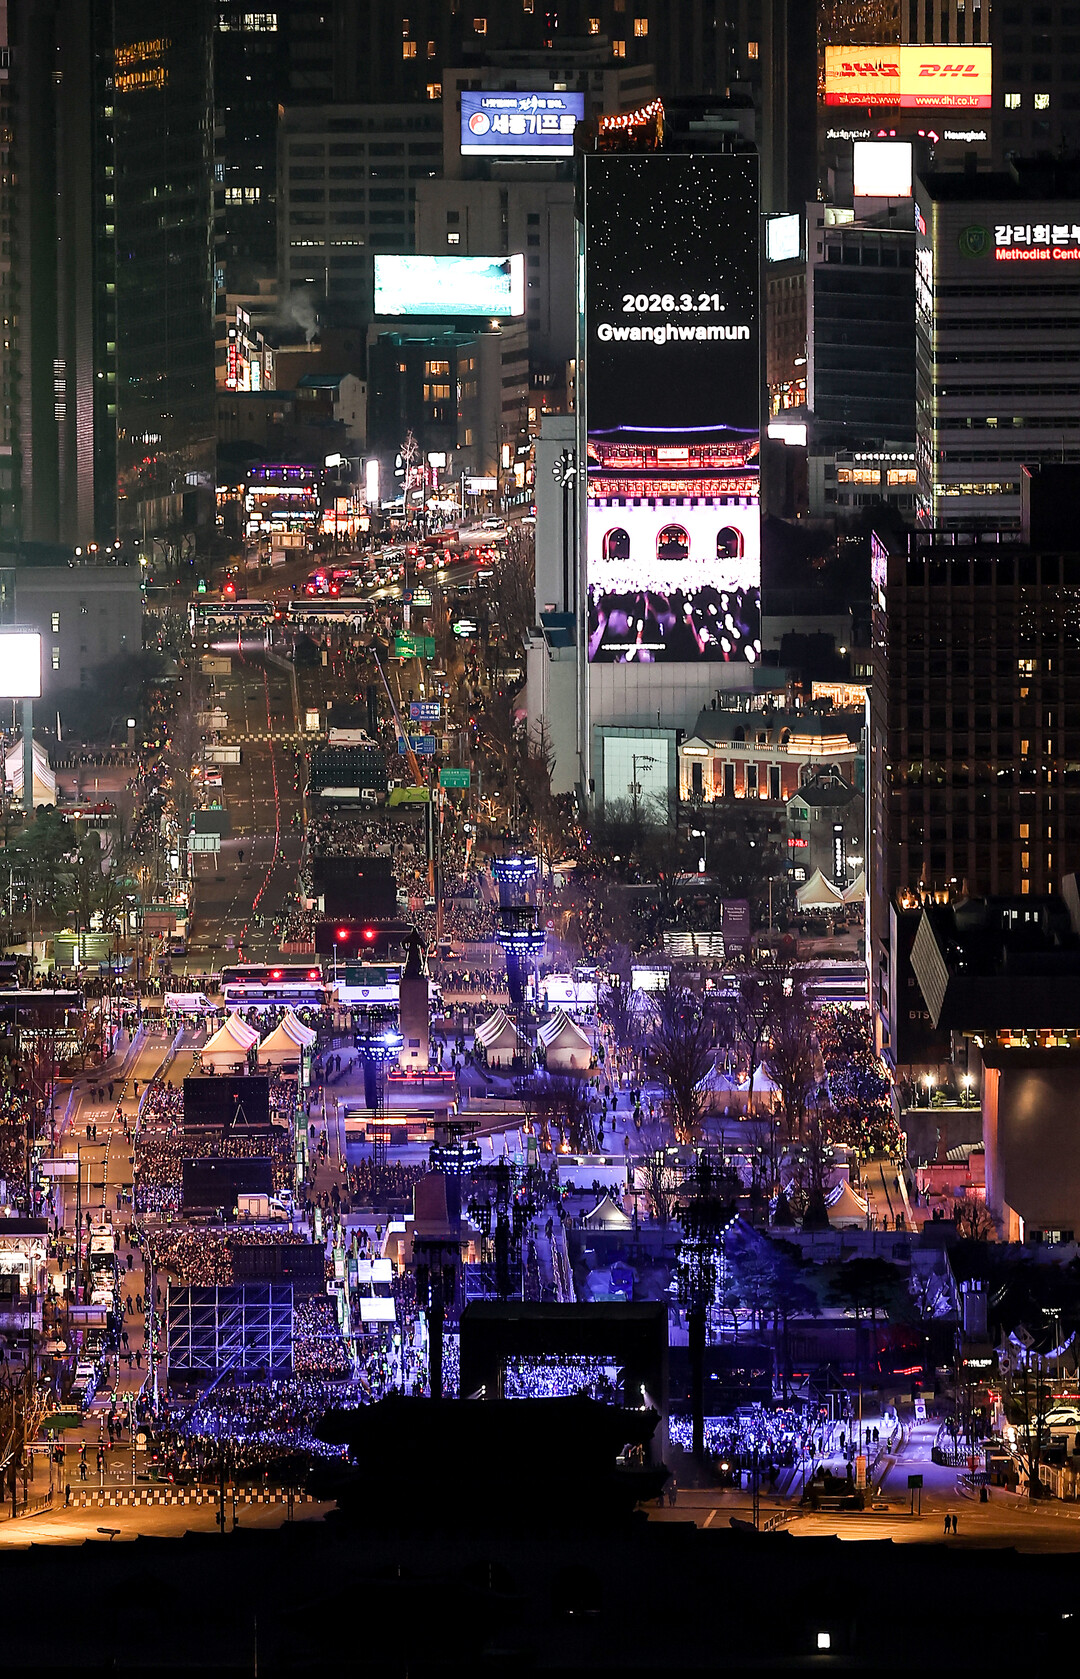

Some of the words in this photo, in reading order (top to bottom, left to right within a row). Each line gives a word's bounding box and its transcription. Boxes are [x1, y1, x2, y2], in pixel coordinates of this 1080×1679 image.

[918, 64, 979, 77] DHL
[916, 96, 979, 105] www.dhl.co.kr
[995, 248, 1051, 260] Methodist
[622, 293, 726, 312] 2026.3.21.
[597, 323, 750, 345] Gwanghwamun
[909, 1010, 930, 1019] BTS
